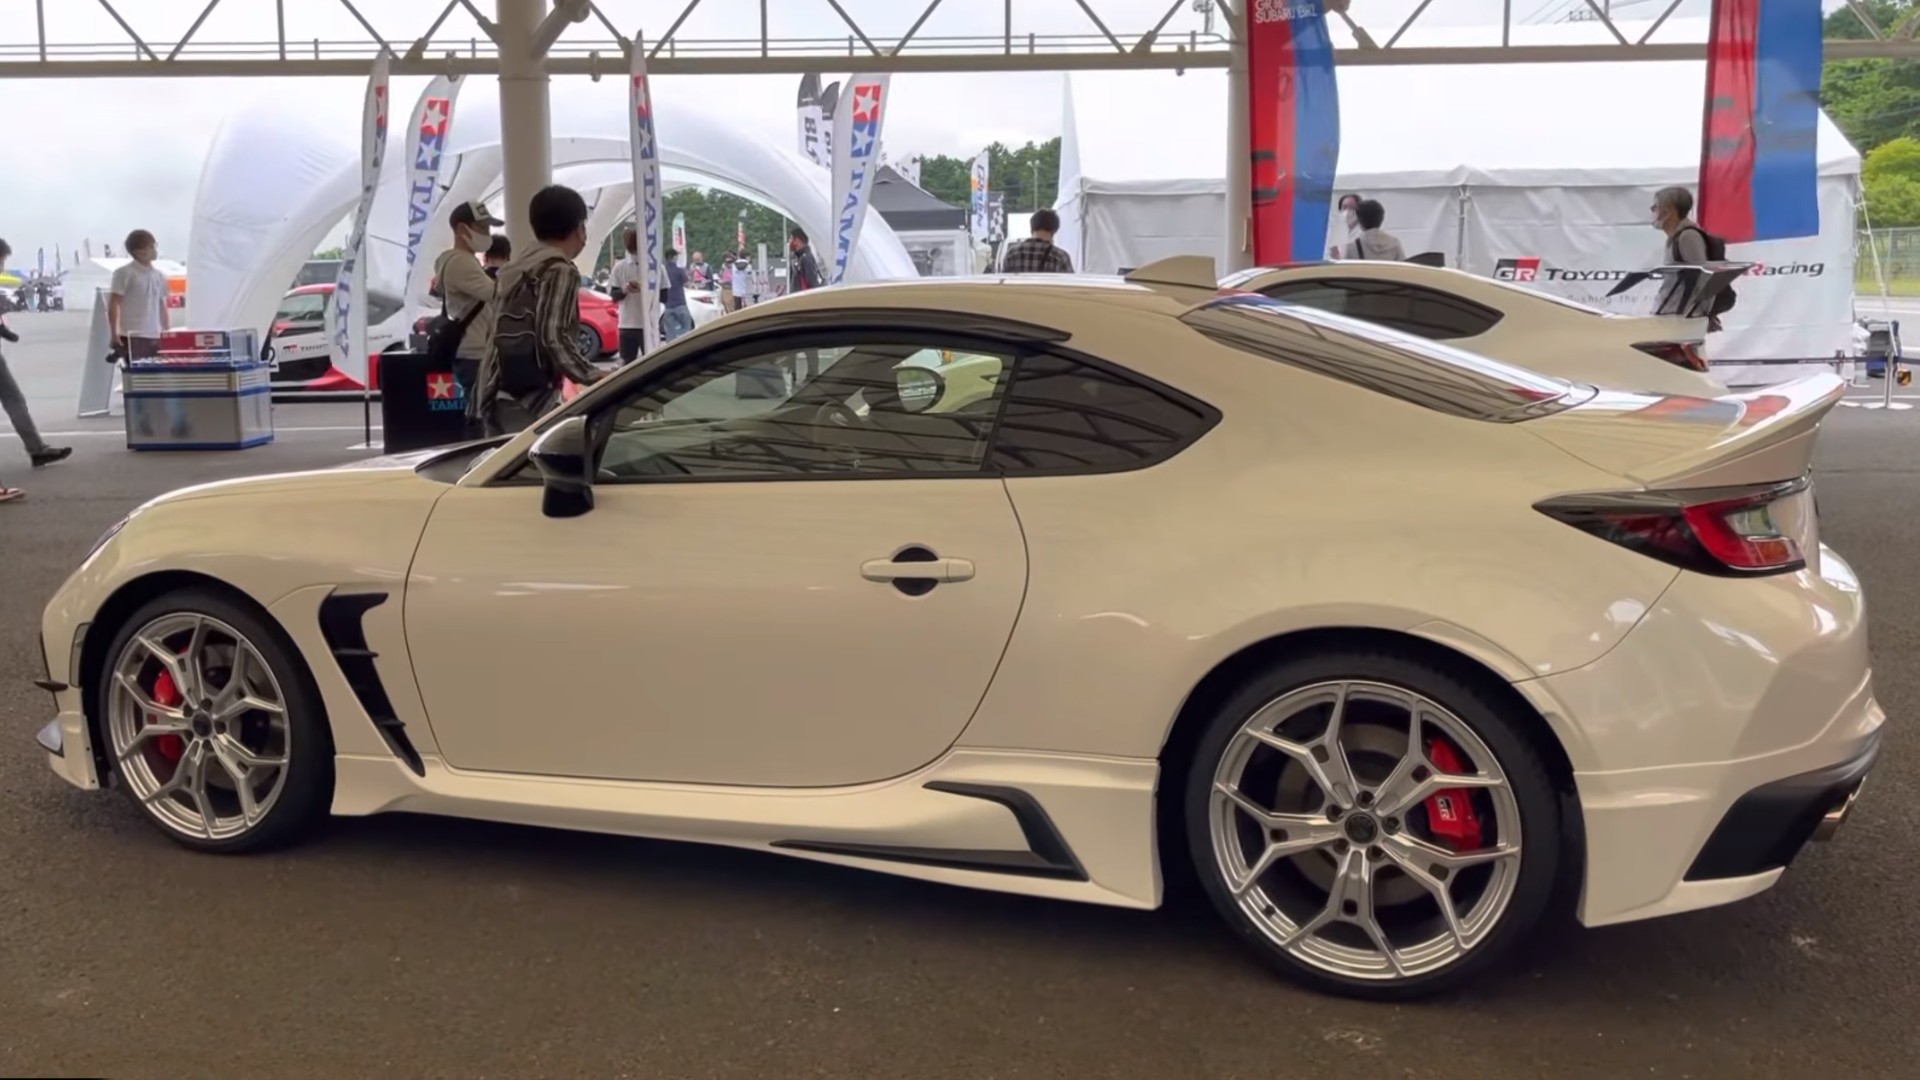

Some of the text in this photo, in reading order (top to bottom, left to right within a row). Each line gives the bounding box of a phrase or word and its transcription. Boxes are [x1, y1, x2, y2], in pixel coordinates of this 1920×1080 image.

[1255, 8, 1296, 23] SUBARU
[643, 165, 659, 291] TAMI
[832, 161, 867, 285] TAMI
[1495, 261, 1824, 282] GR TOYOT Racing
[428, 400, 464, 411] TAMI
